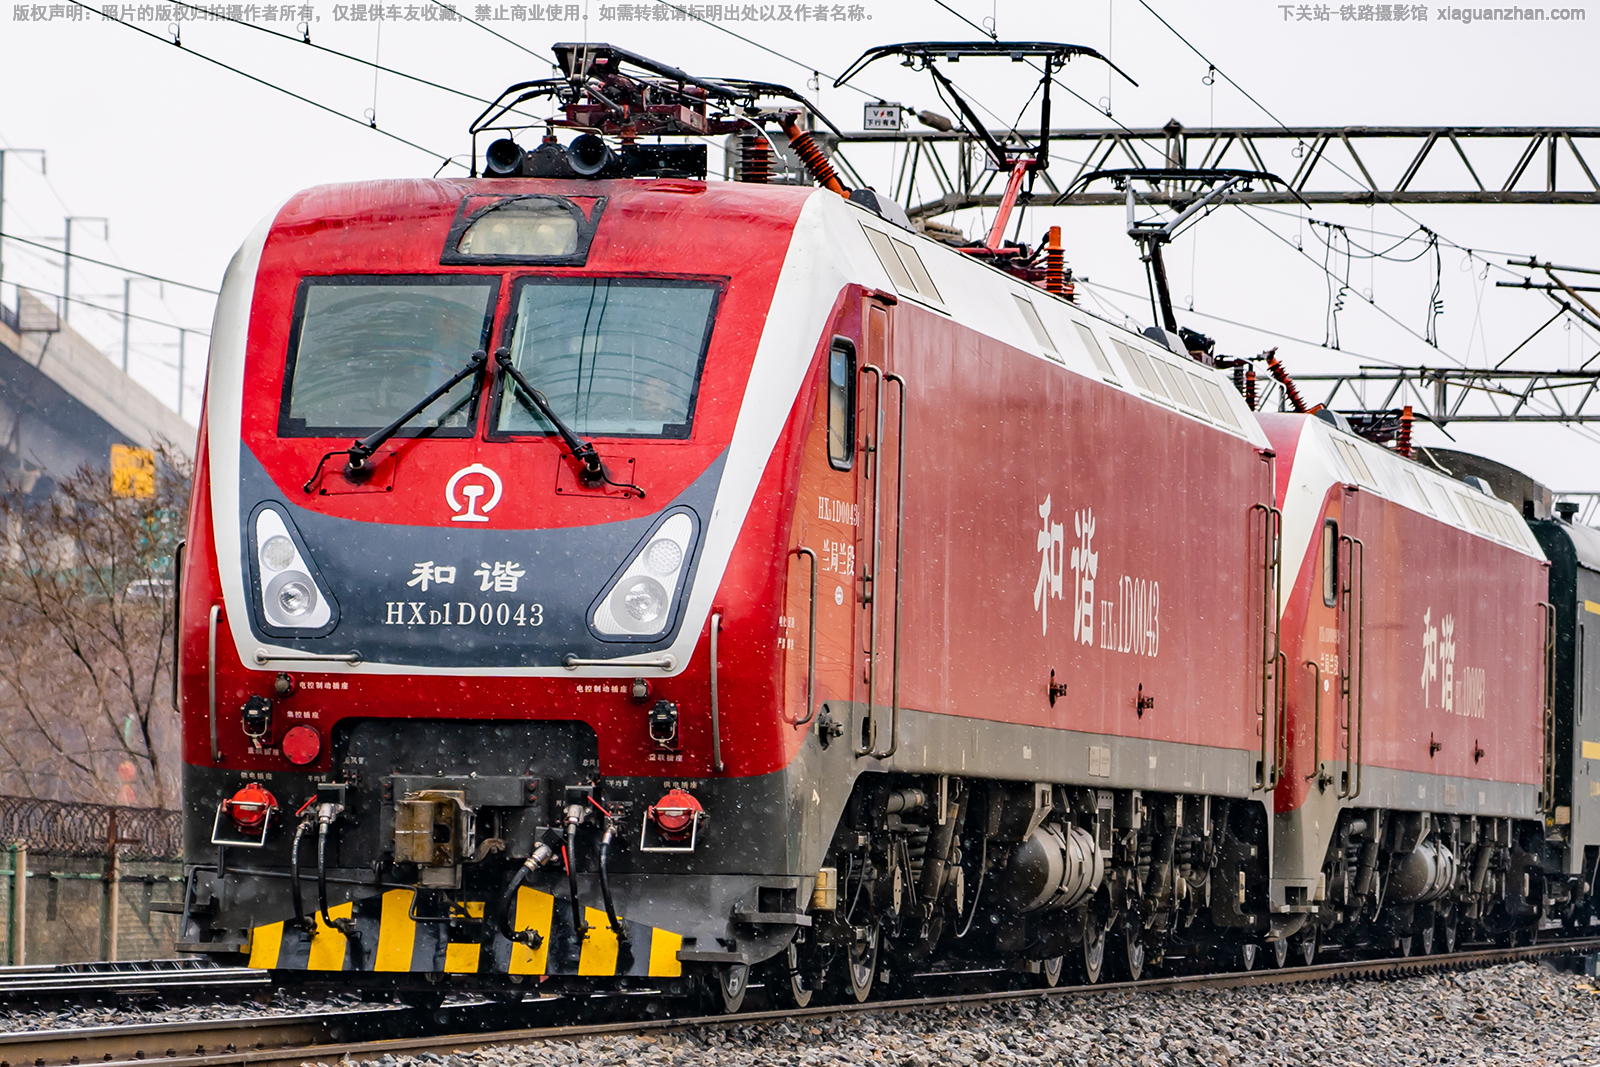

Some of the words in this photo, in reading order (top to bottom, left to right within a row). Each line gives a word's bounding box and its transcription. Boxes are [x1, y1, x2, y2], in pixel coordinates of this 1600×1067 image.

[821, 539, 855, 576] 兰局兰段
[1033, 493, 1099, 647] 和谐
[406, 560, 526, 593] 和谐
[385, 602, 544, 627] HXD1D0043
[1421, 606, 1456, 713] 和谐
